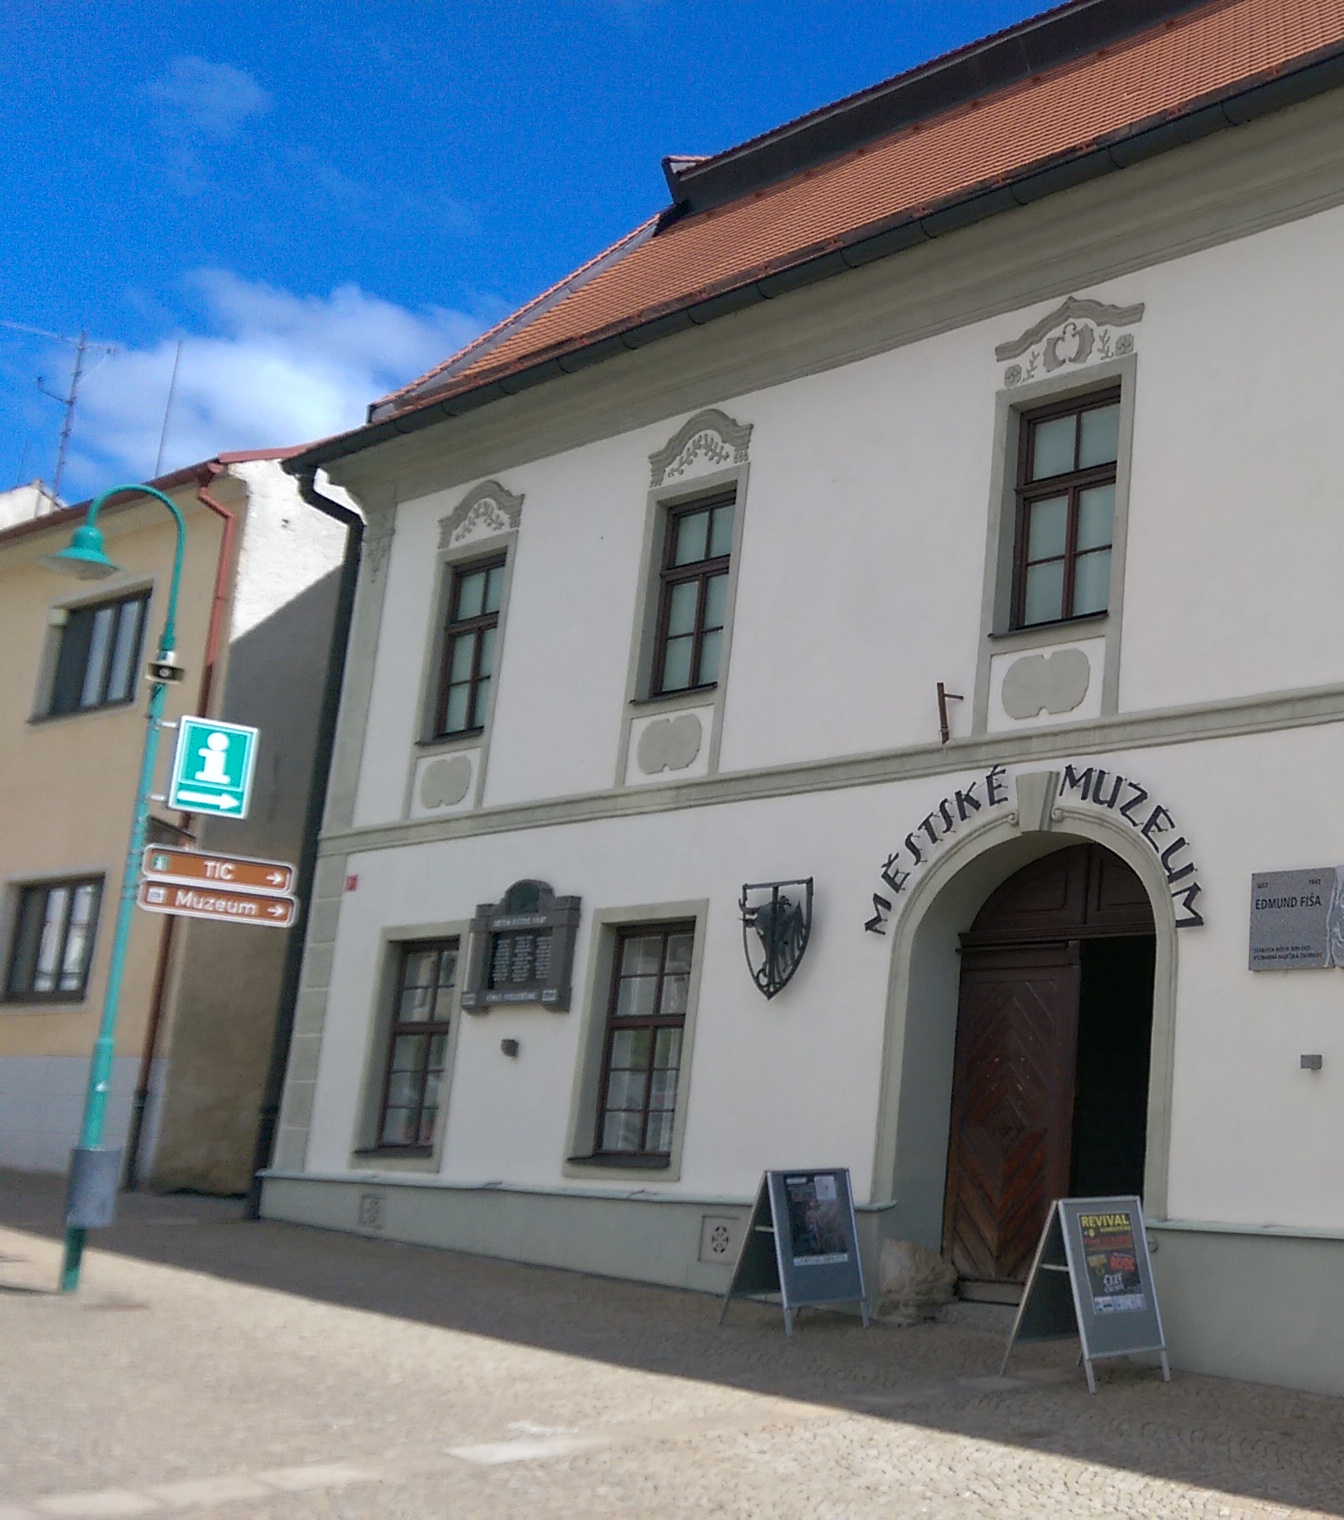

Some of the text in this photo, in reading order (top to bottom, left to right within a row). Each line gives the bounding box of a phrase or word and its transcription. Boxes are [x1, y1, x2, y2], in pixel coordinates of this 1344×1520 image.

[863, 763, 1205, 935] MĚSTSKÉ MUZEUM
[203, 860, 235, 880] TIC
[175, 889, 258, 915] Muzeum
[1255, 892, 1322, 910] EDMUND FIŠA
[1081, 1214, 1129, 1228] REVIVAL
